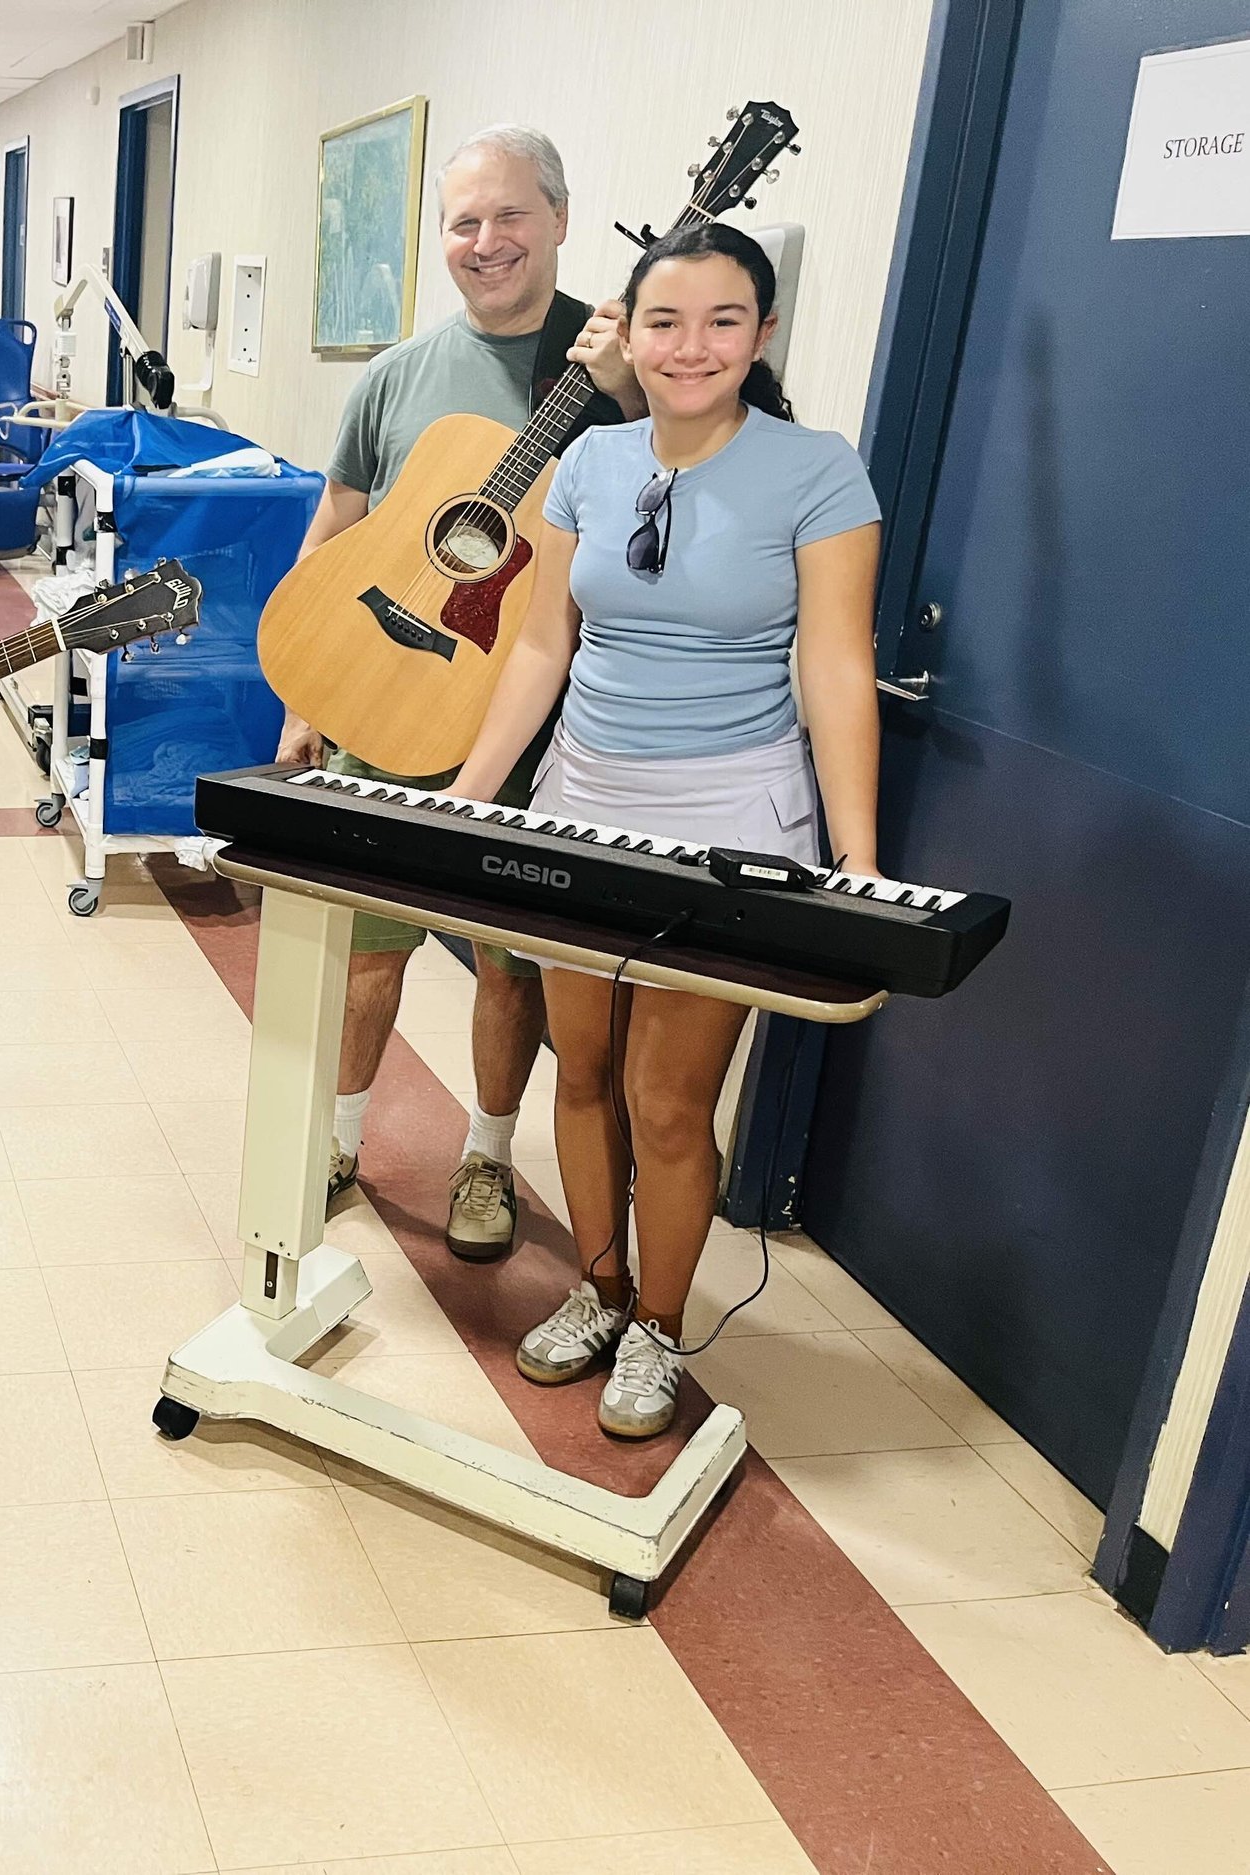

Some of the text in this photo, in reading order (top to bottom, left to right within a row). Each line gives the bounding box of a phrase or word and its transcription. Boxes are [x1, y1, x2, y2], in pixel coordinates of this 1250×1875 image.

[1163, 132, 1245, 159] STORAGE
[164, 578, 192, 610] GUILD
[481, 855, 571, 889] CASIO
